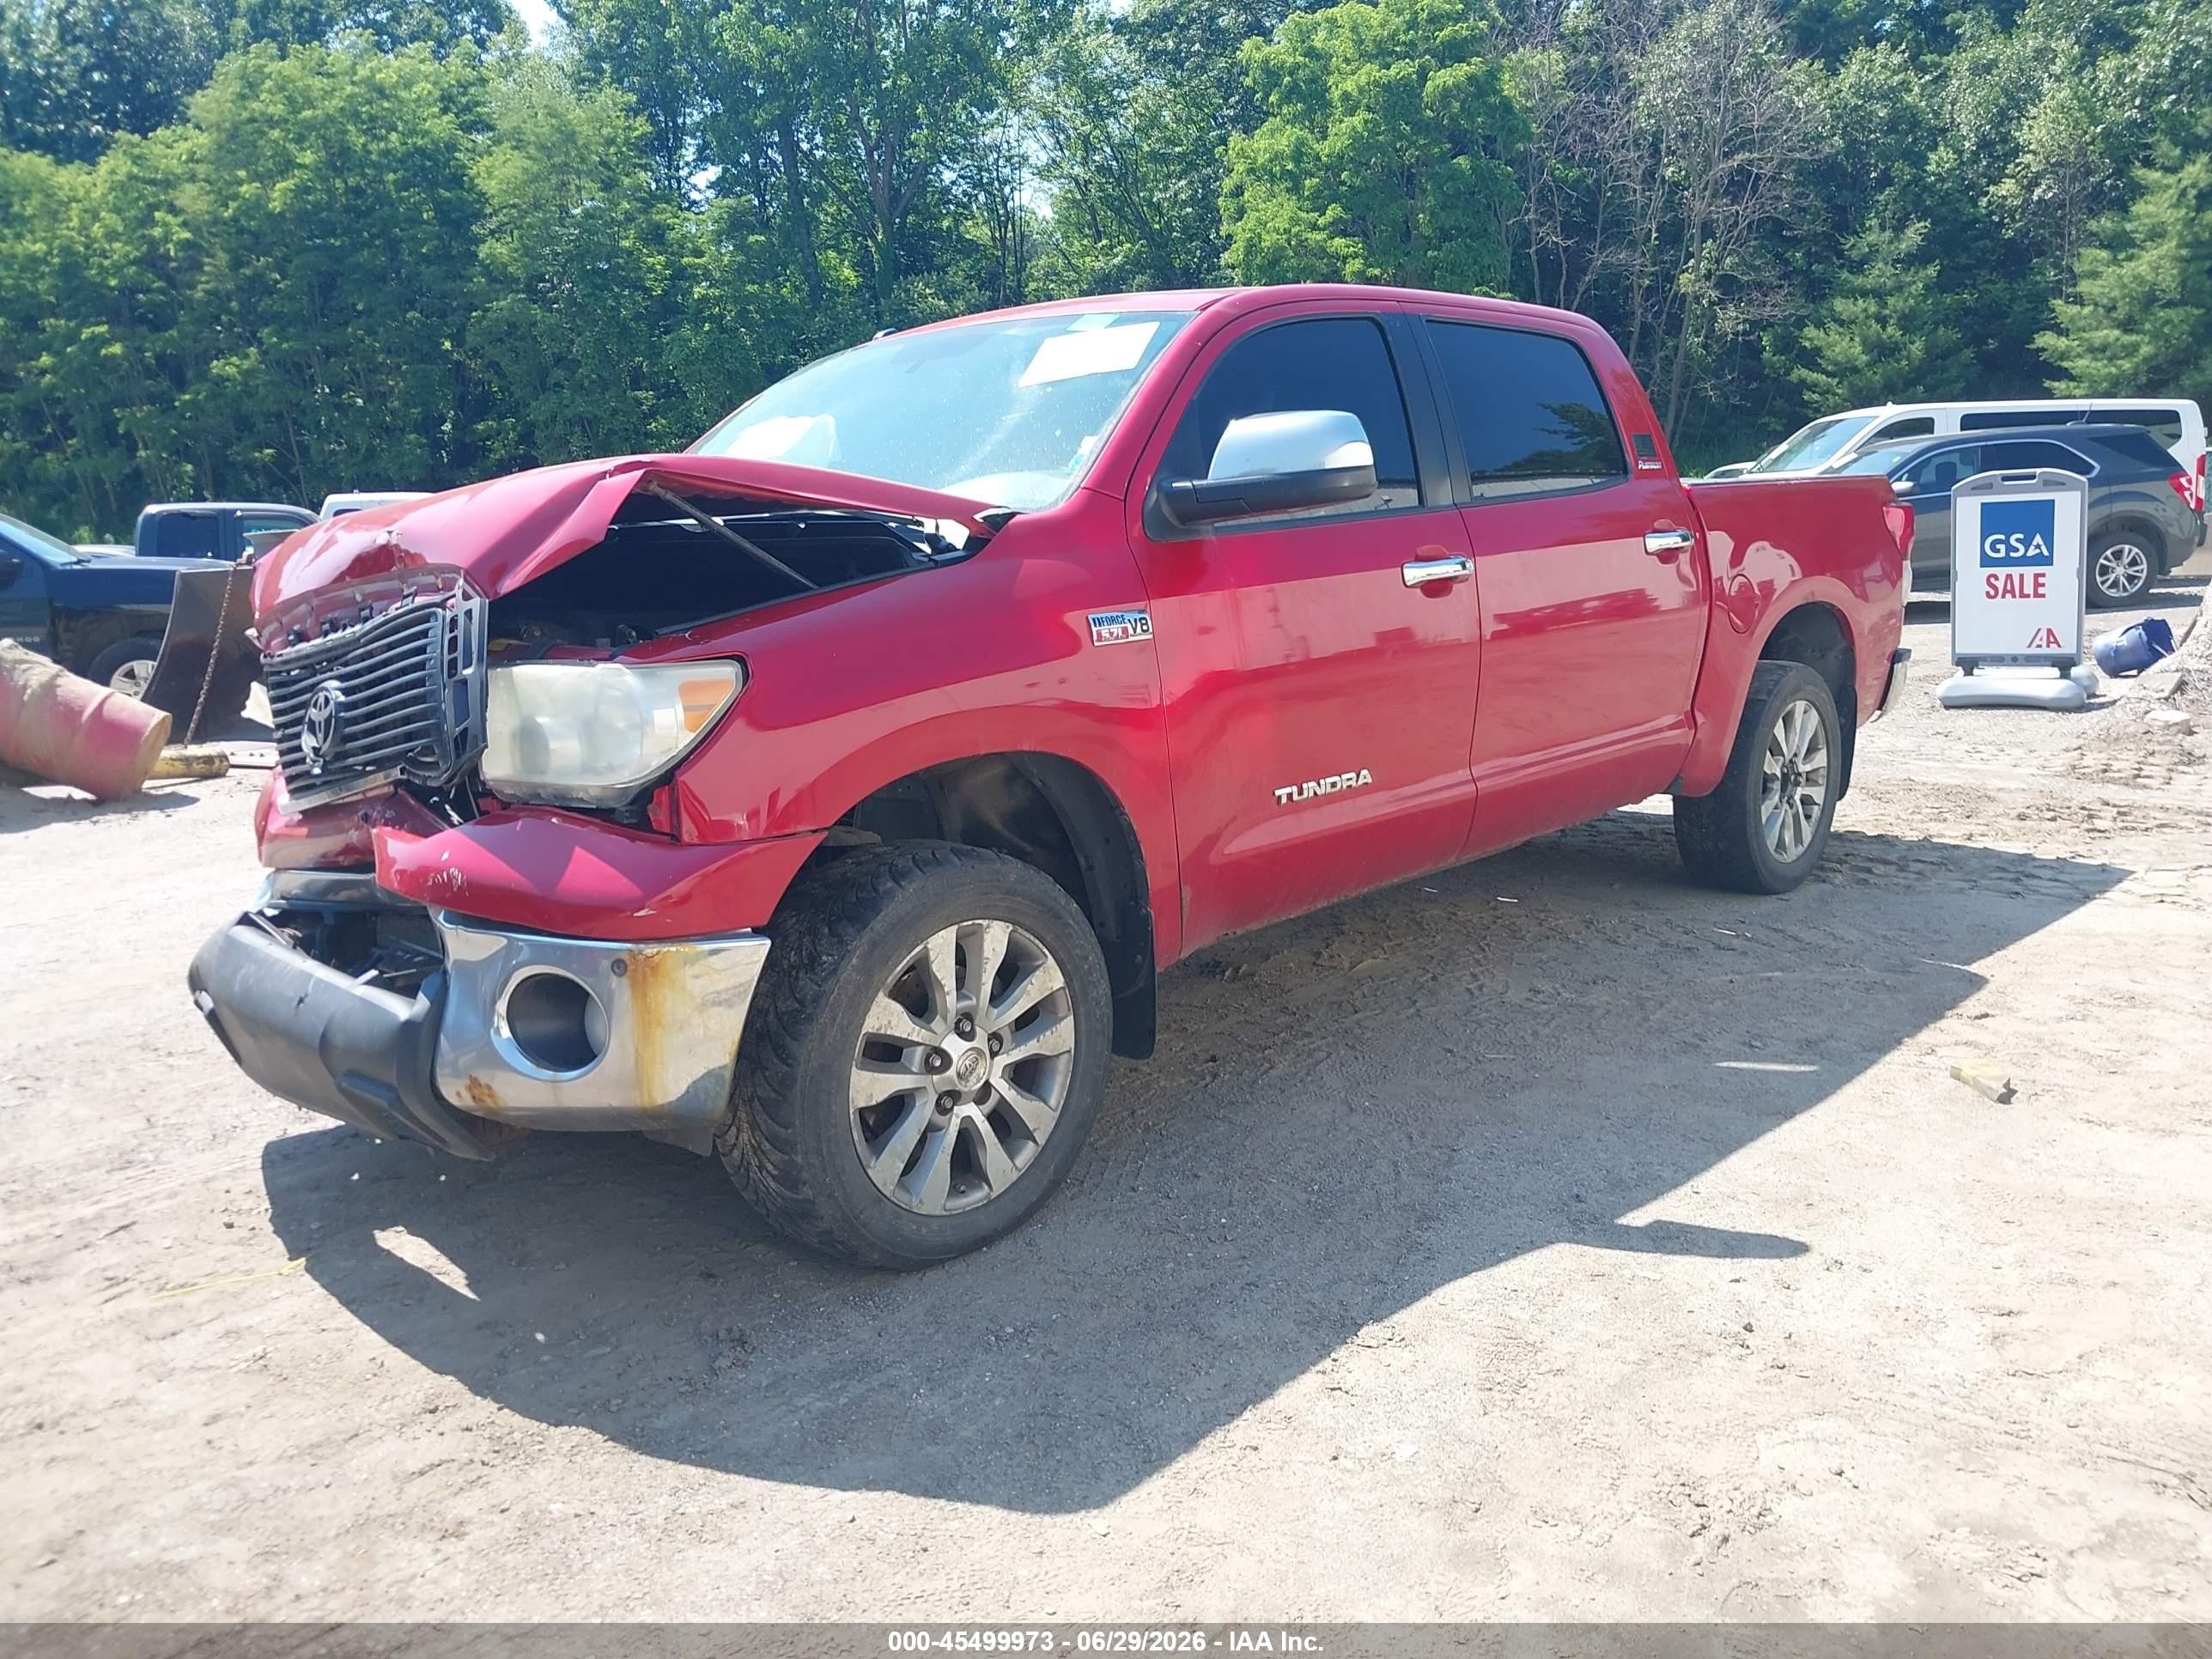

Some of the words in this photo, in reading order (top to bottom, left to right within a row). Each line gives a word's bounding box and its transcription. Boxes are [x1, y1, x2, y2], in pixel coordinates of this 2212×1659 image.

[1984, 532, 2050, 558] GSA
[1985, 573, 2046, 599] SALE
[1127, 617, 1150, 635] V8
[1273, 769, 1372, 805] TUNDRA
